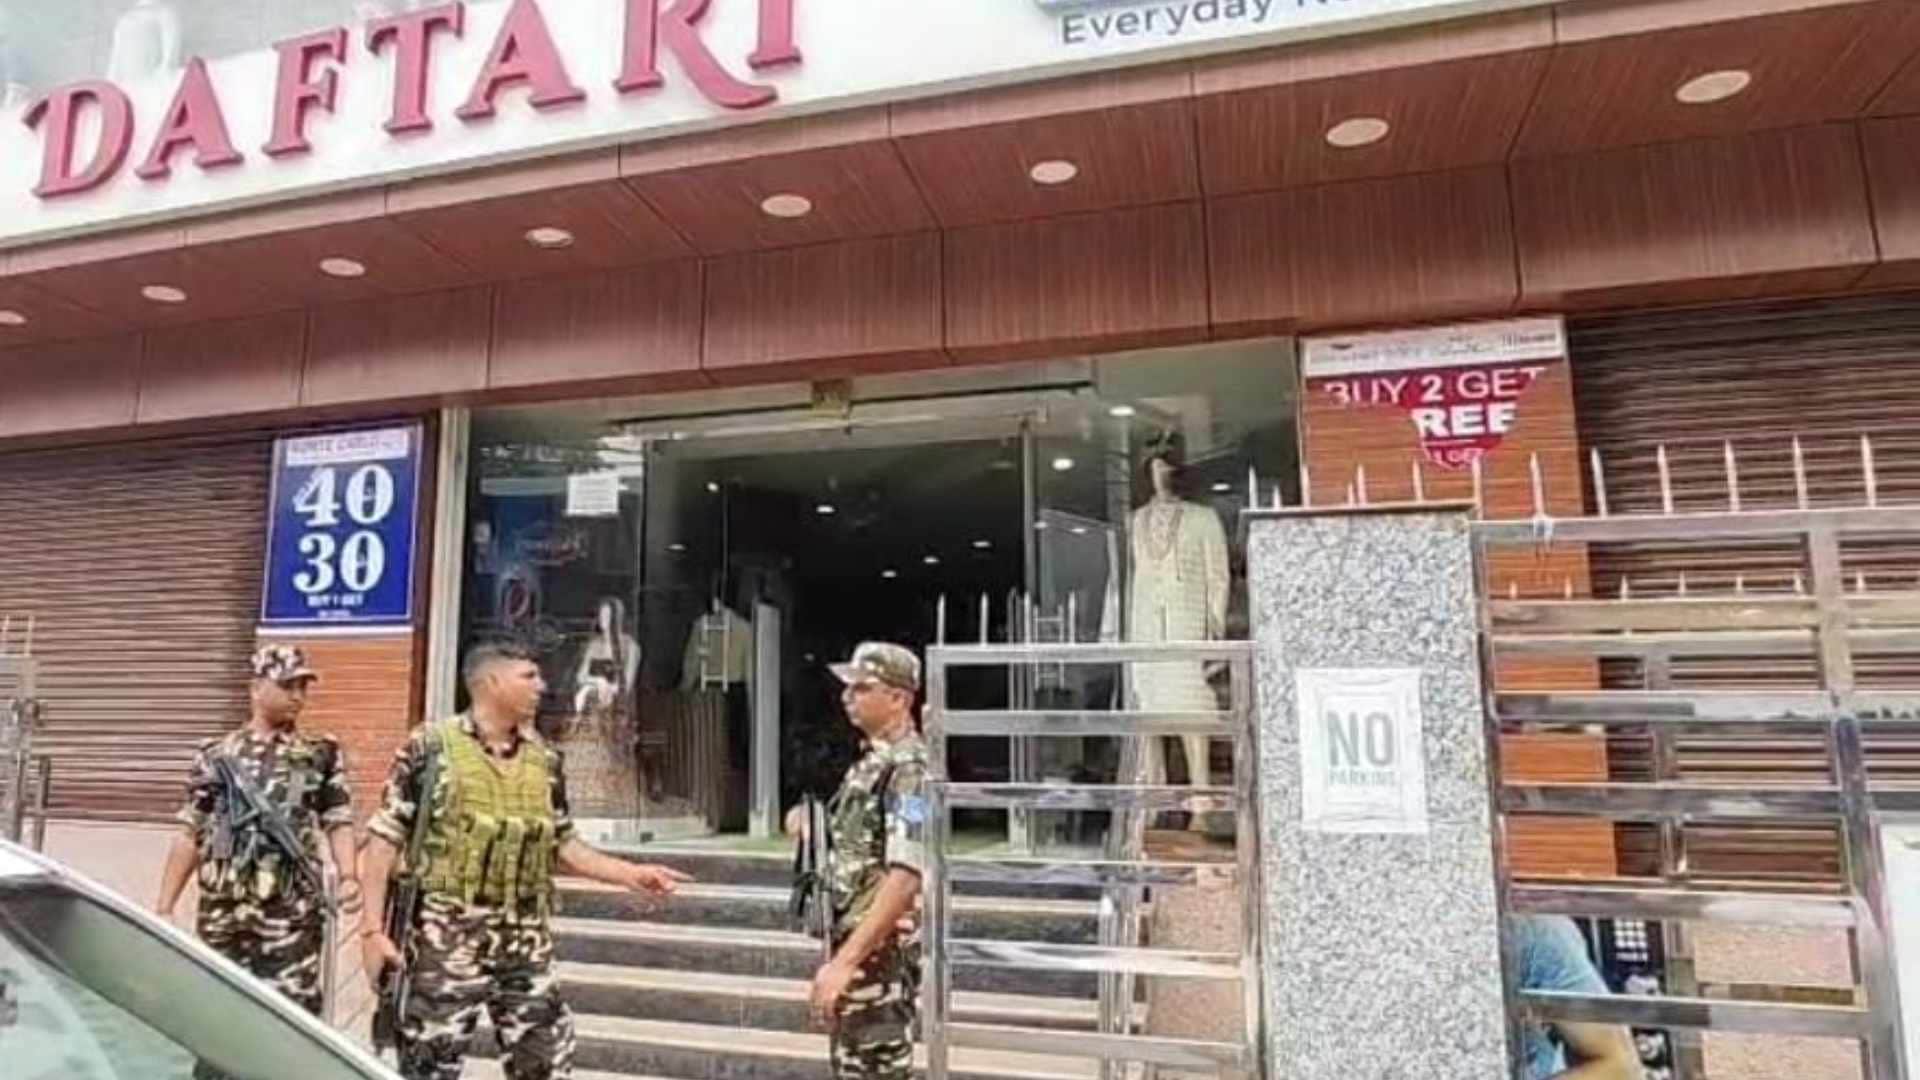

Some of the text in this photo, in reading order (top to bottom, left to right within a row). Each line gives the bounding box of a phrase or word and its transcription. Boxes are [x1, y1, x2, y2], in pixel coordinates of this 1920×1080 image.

[1061, 0, 1271, 44] Everyday
[24, 0, 803, 198] DAFTARI
[1420, 374, 1445, 402] 2
[1410, 402, 1517, 438] REE
[293, 464, 395, 526] 40
[293, 530, 386, 593] 30
[1327, 711, 1394, 766] NO
